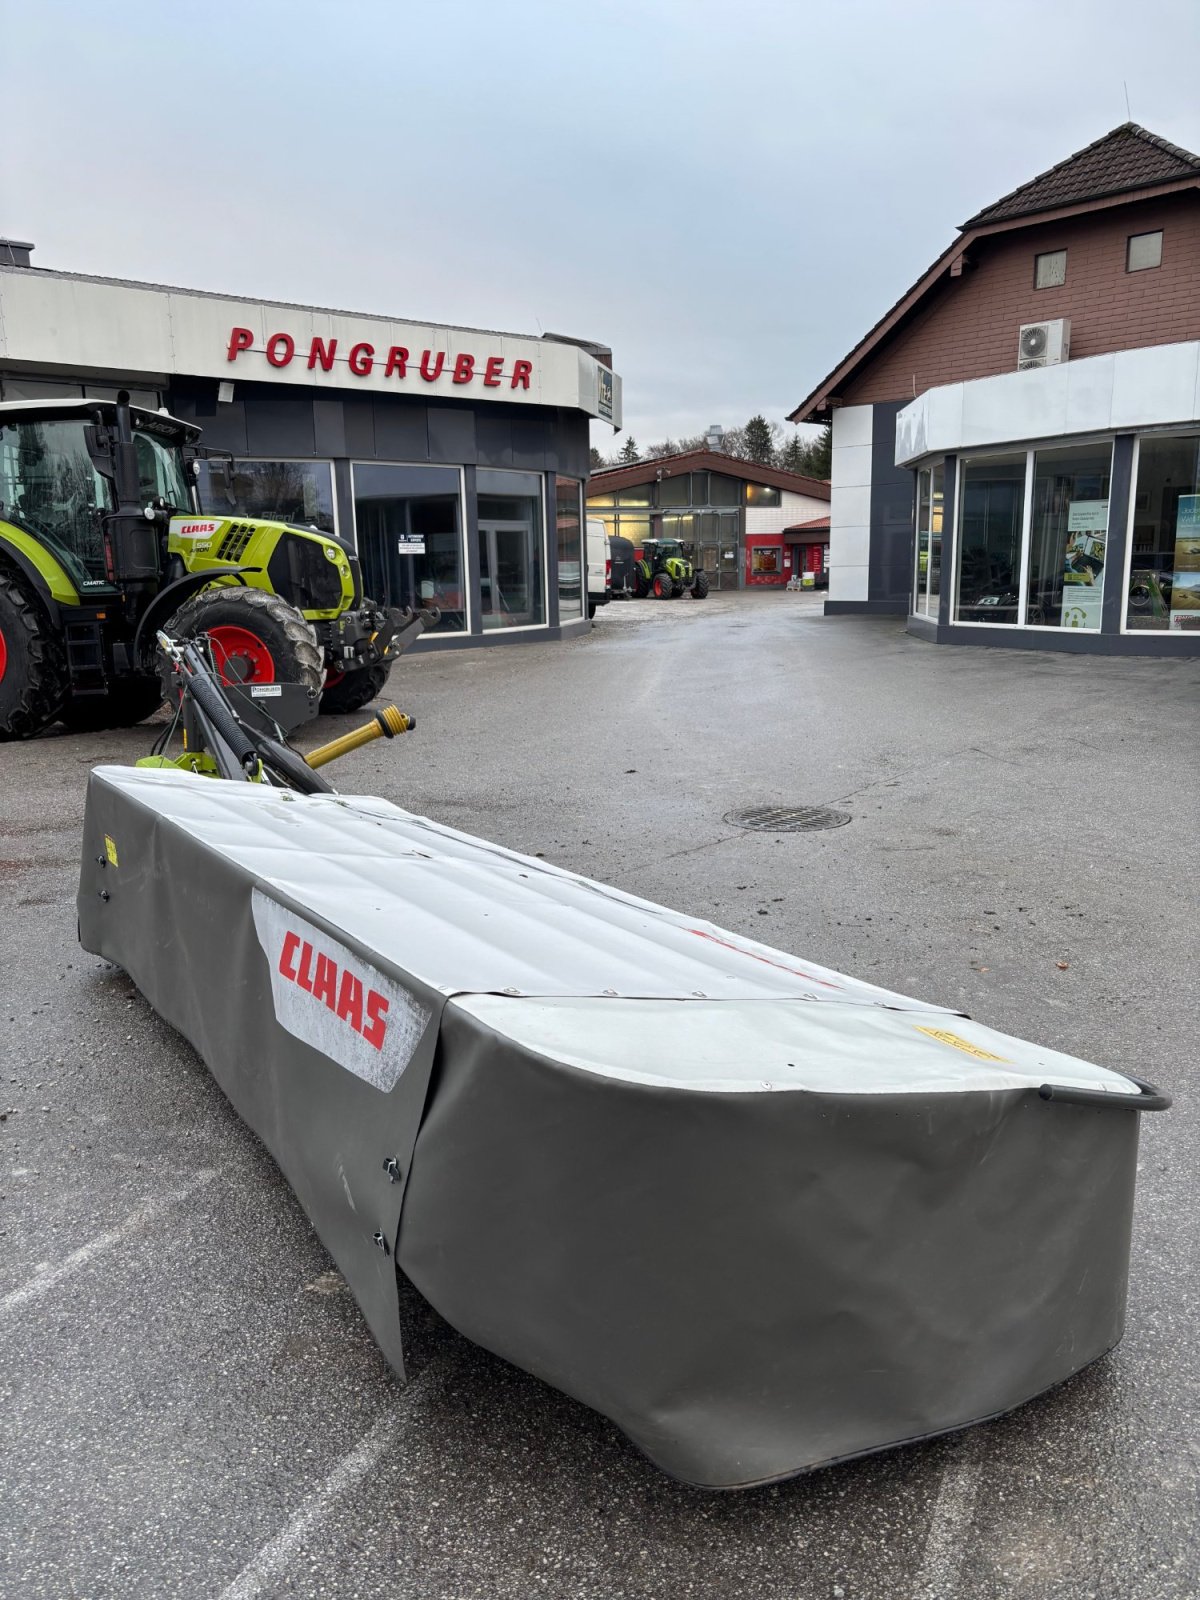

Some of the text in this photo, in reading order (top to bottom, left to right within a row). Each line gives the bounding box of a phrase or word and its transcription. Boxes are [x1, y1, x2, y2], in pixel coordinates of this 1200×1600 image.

[226, 327, 533, 390] PONGRUBER
[181, 523, 215, 534] CLAAS
[279, 930, 390, 1052] CLAAS
